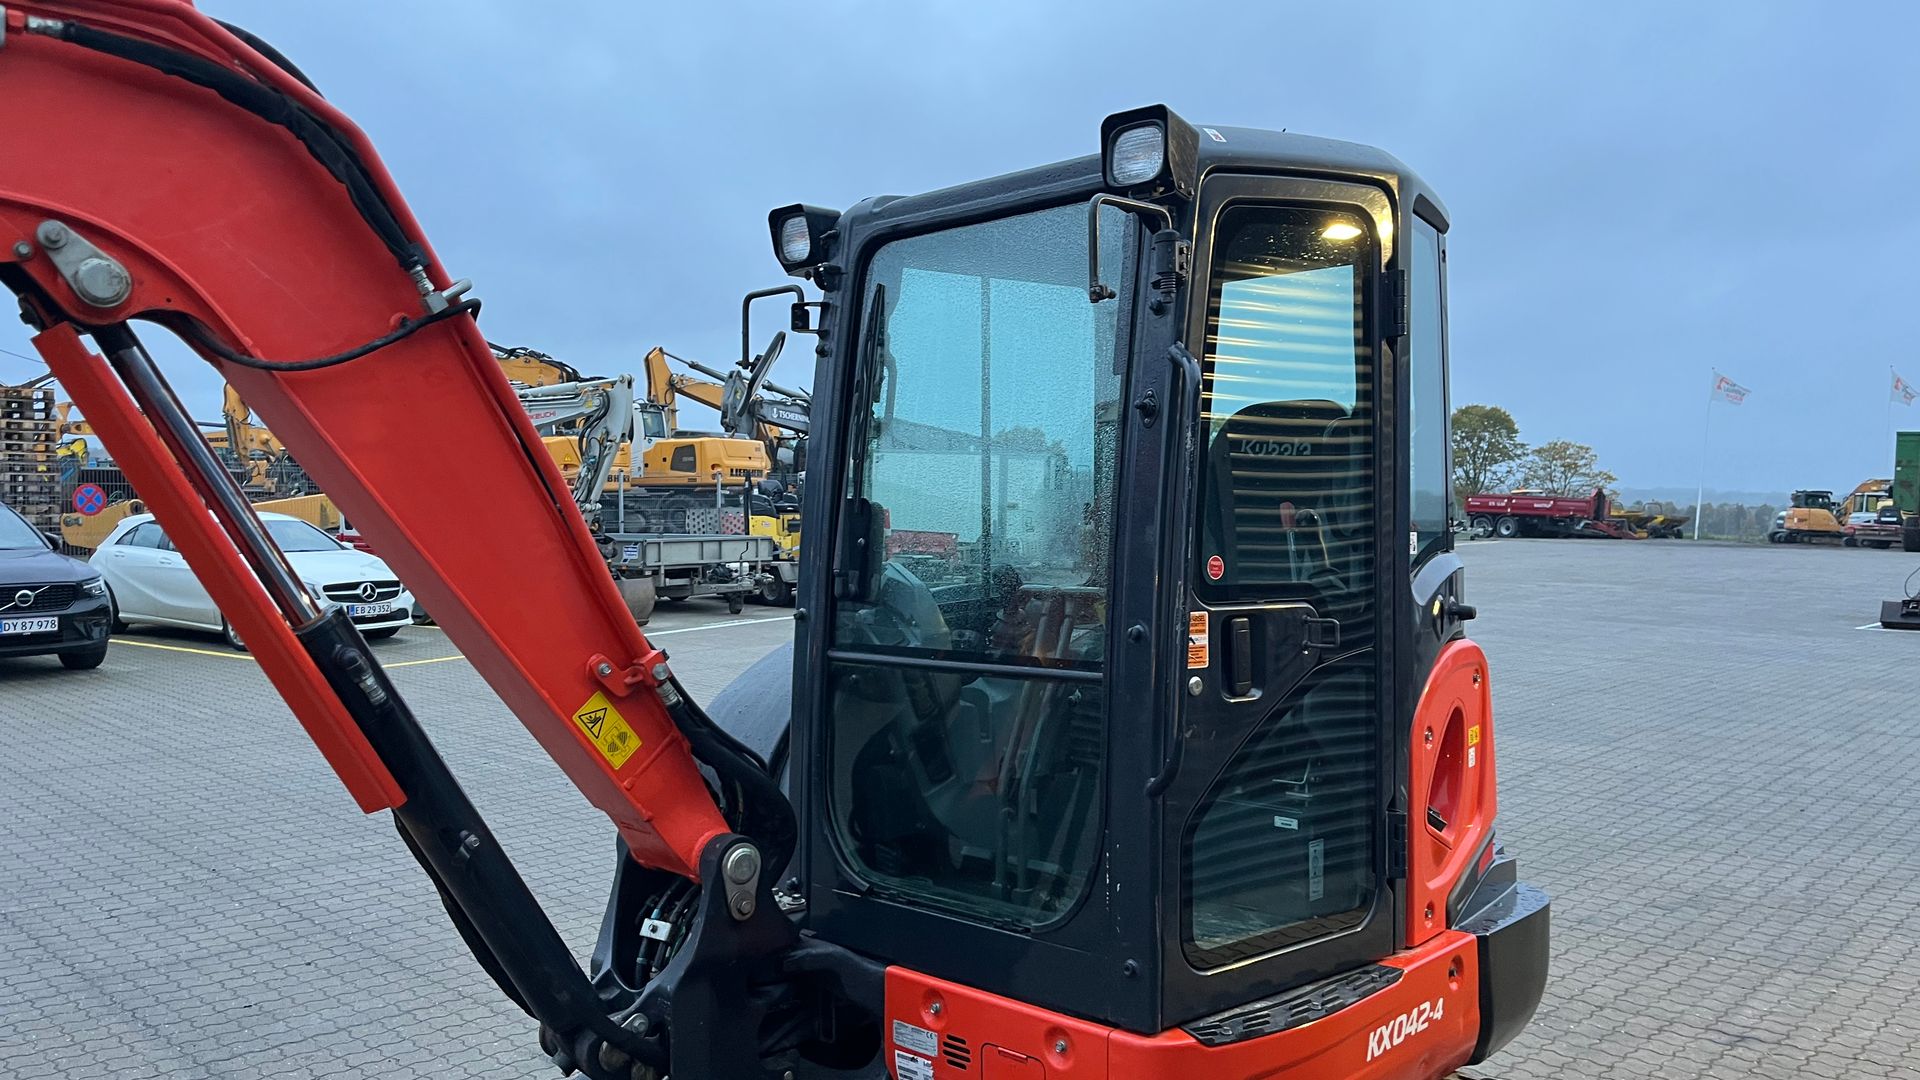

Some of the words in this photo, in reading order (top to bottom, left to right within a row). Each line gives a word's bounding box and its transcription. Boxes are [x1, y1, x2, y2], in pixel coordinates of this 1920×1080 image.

[528, 410, 557, 419] KEUCHI
[355, 606, 366, 615] EB
[367, 605, 377, 614] 29
[377, 604, 390, 613] 352
[3, 621, 18, 632] DY
[20, 620, 34, 631] 87
[36, 619, 57, 630] 978
[1366, 997, 1444, 1063] KX042-4
